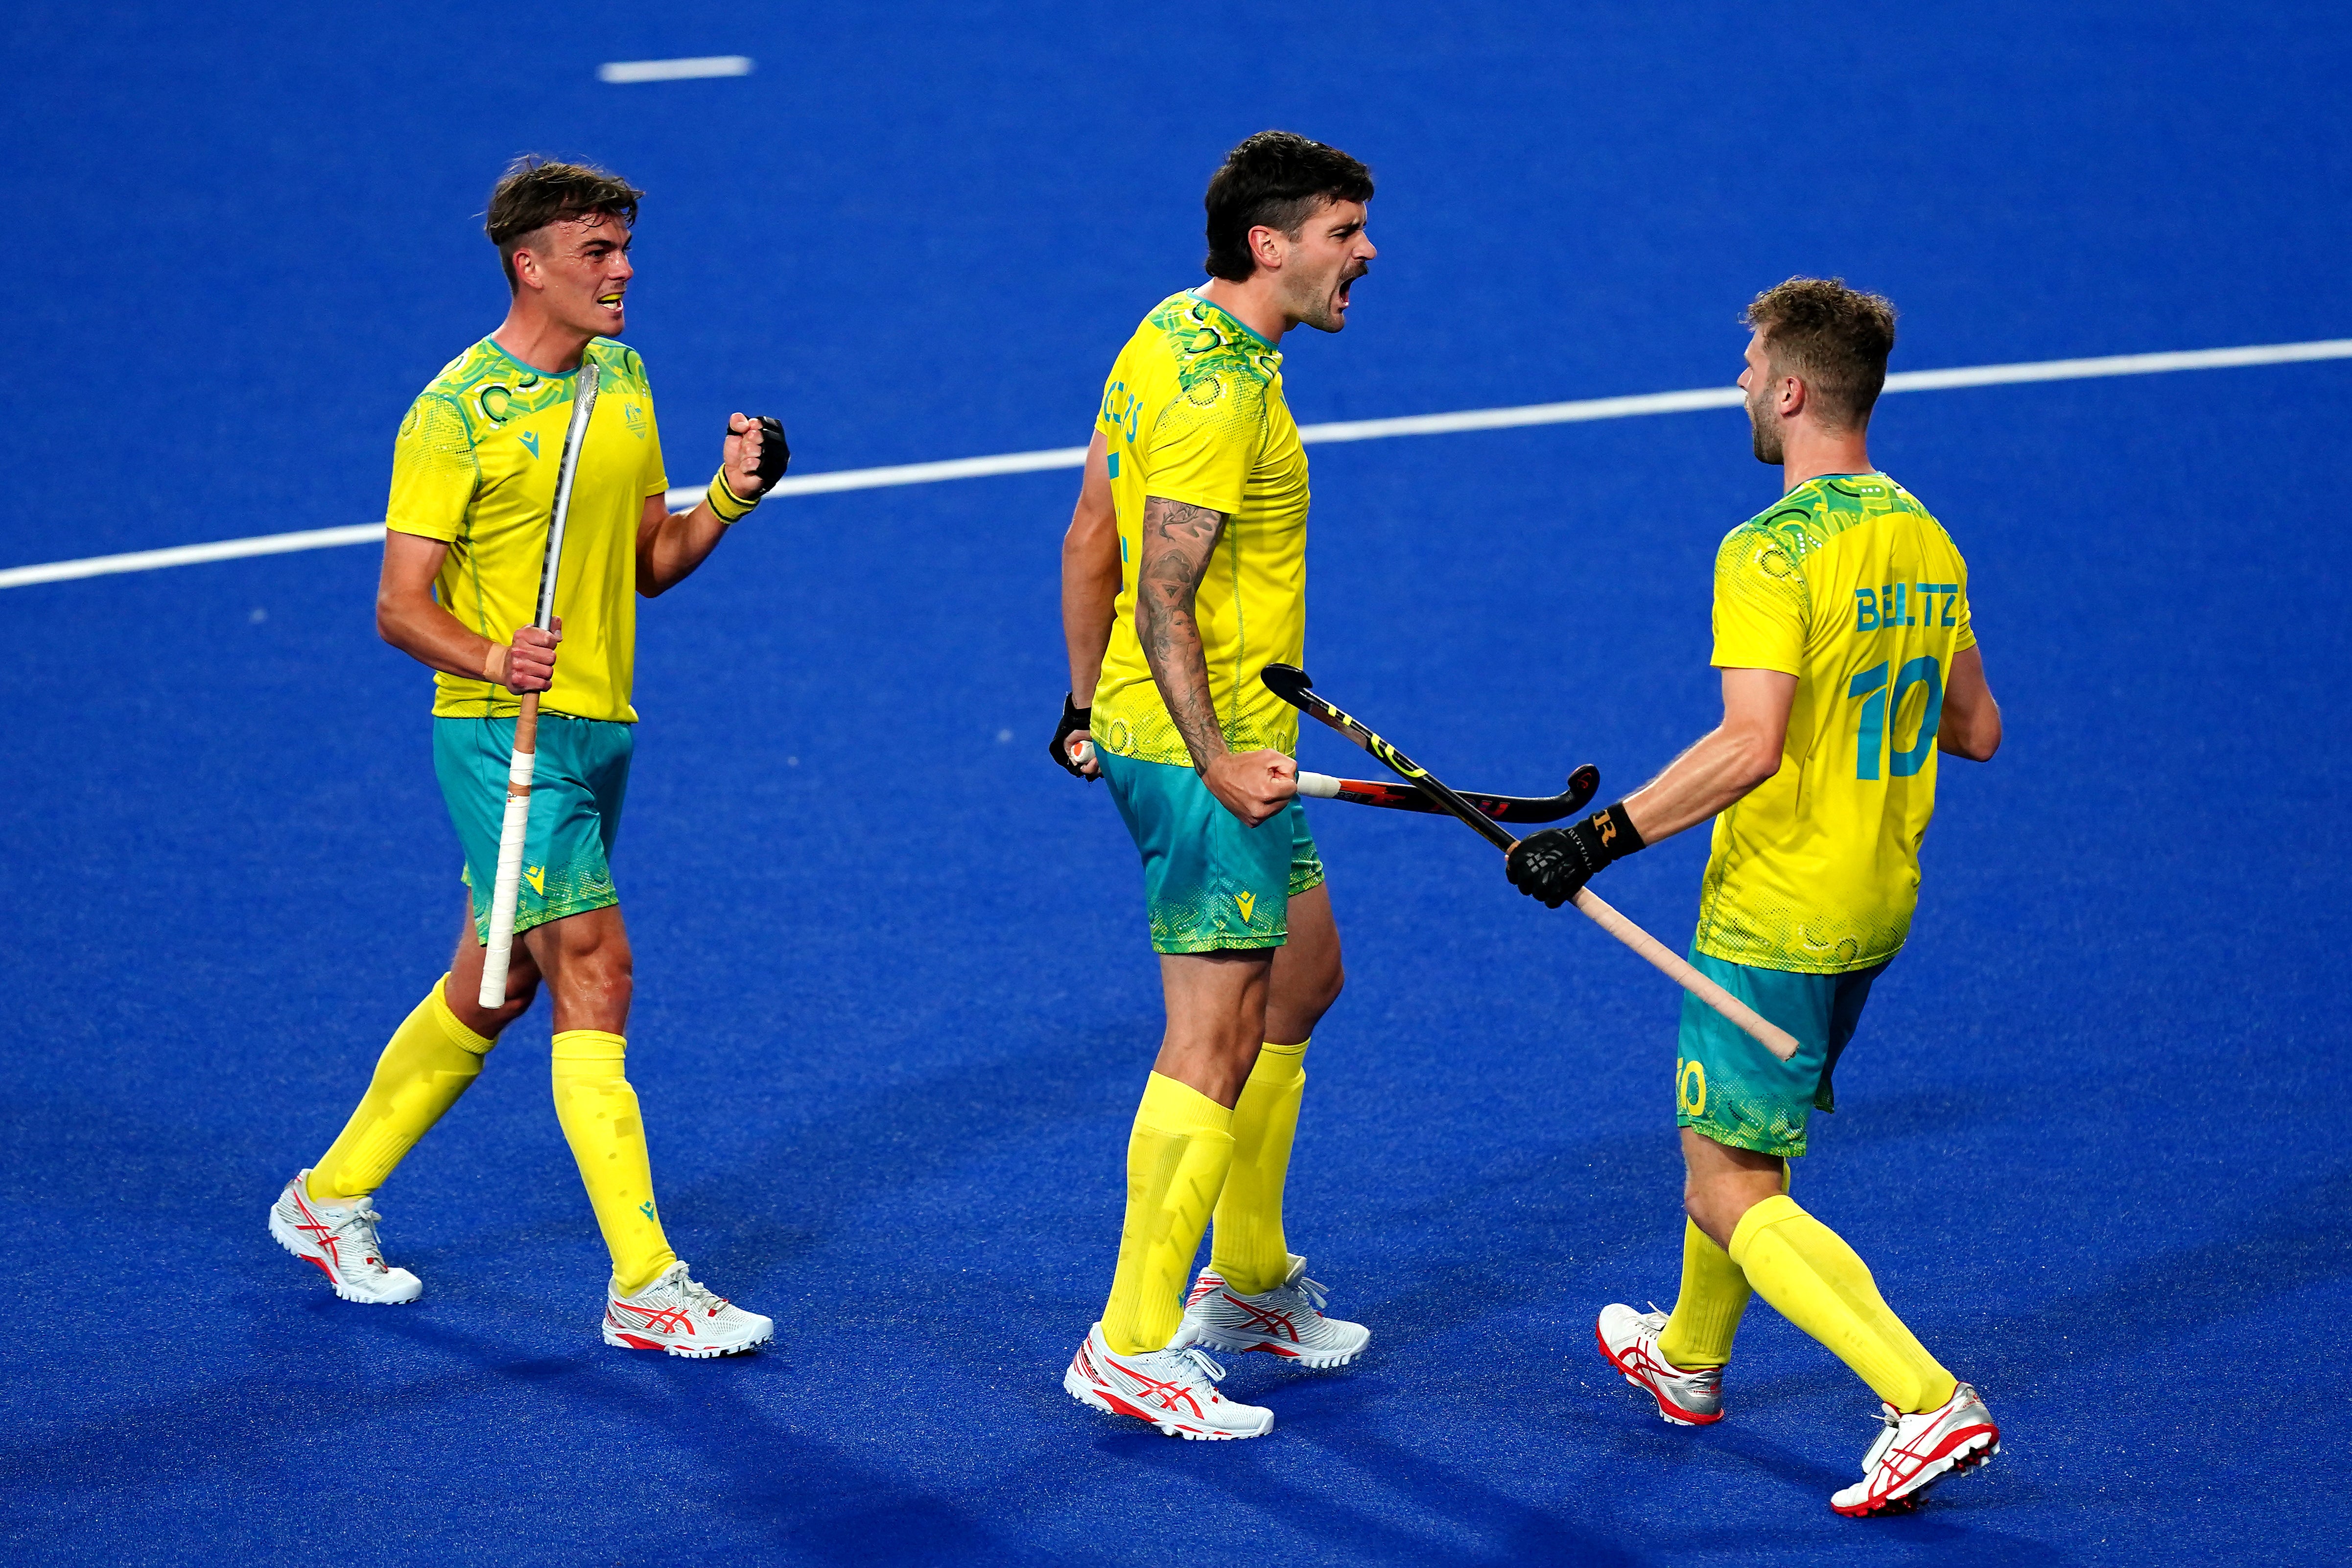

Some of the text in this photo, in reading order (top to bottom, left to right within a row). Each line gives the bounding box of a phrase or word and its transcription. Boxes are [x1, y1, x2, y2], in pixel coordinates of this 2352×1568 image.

[1855, 583, 1958, 632] BELTZ
[1848, 655, 1944, 780] 10
[1567, 828, 1593, 870] RITUAL
